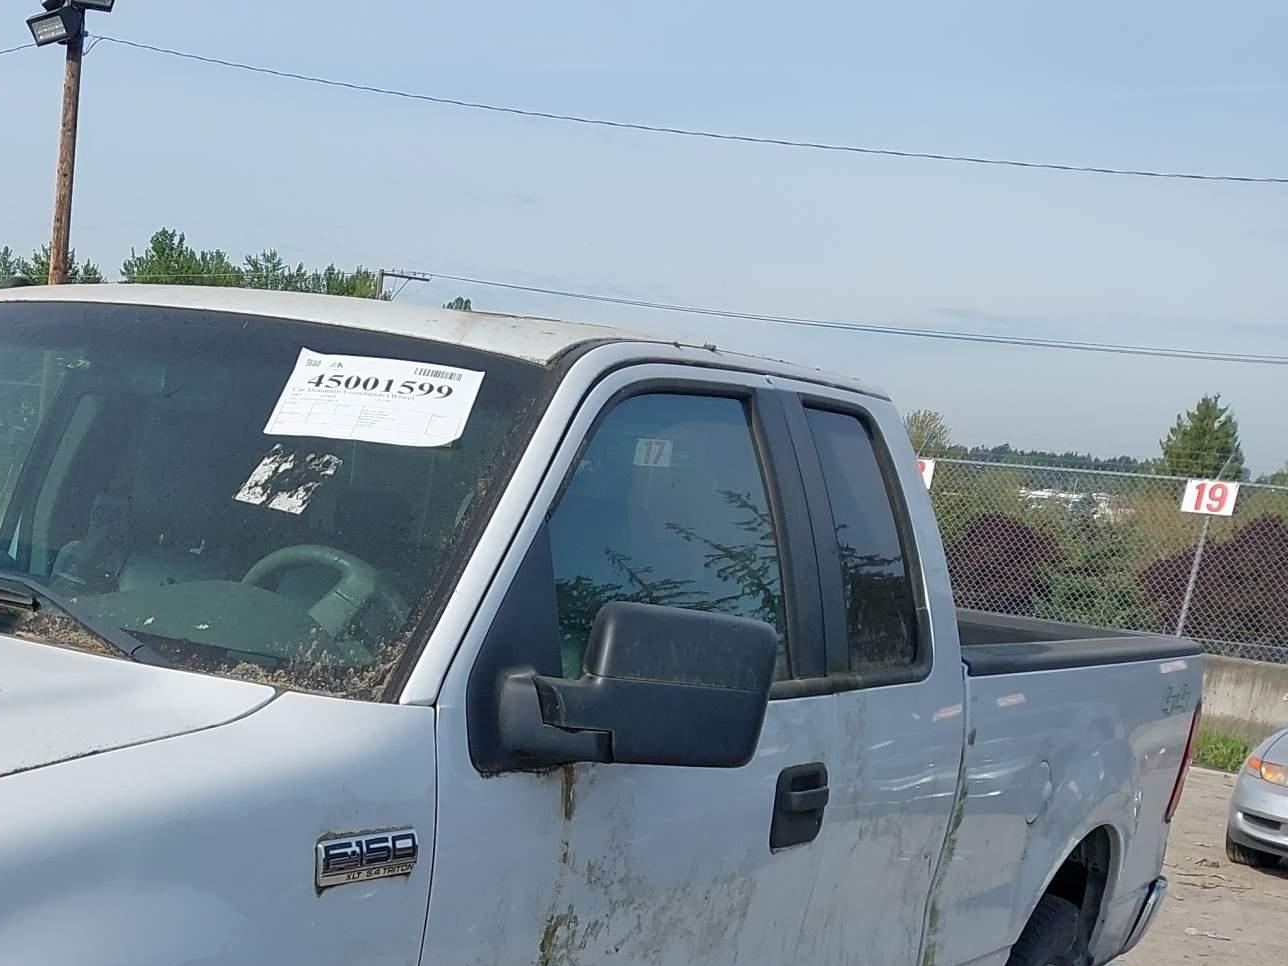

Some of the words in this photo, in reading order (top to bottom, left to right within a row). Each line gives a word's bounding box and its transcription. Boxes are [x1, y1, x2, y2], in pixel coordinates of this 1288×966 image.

[307, 372, 453, 400] 45001599
[644, 440, 665, 465] 17
[1194, 482, 1228, 512] 19
[345, 871, 362, 881] XLT
[383, 863, 414, 875] TRITON
